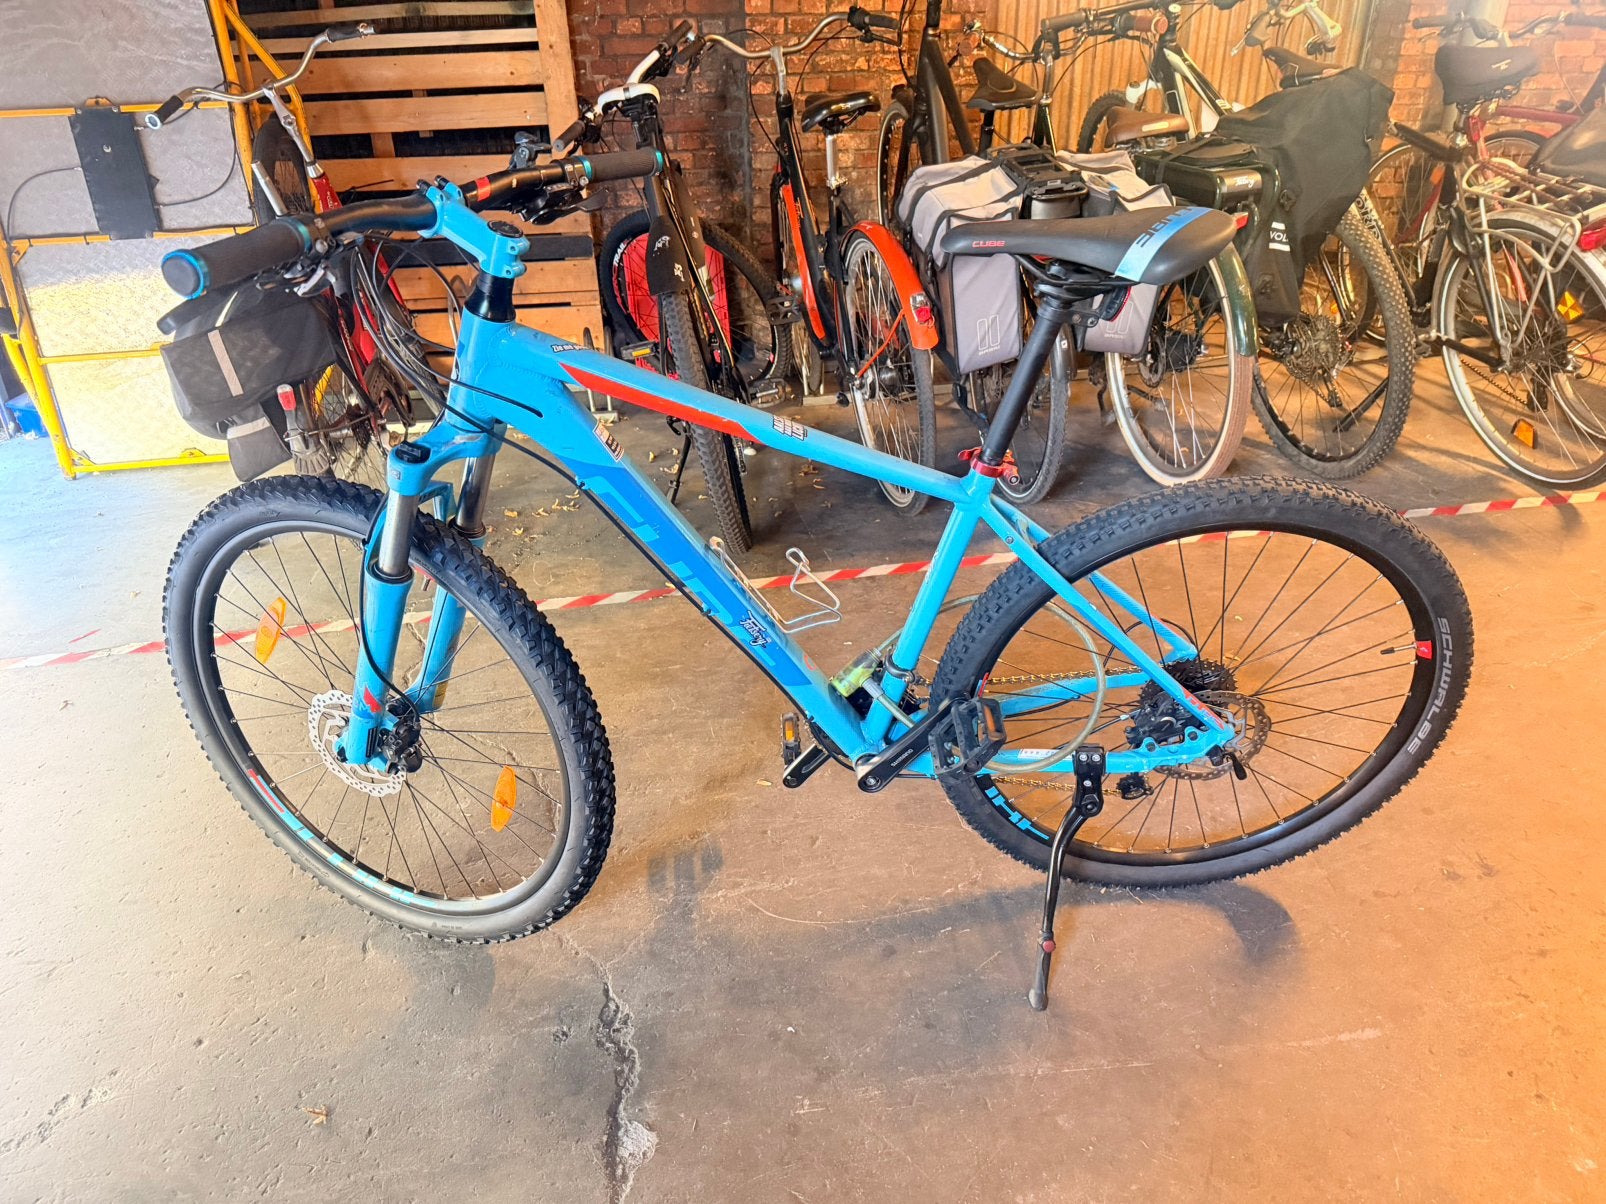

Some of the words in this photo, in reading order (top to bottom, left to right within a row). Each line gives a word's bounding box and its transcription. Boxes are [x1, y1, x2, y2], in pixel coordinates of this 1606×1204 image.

[1269, 231, 1288, 242] VOL
[972, 240, 1006, 248] CUBE
[1407, 616, 1453, 755] SCHWALBE
